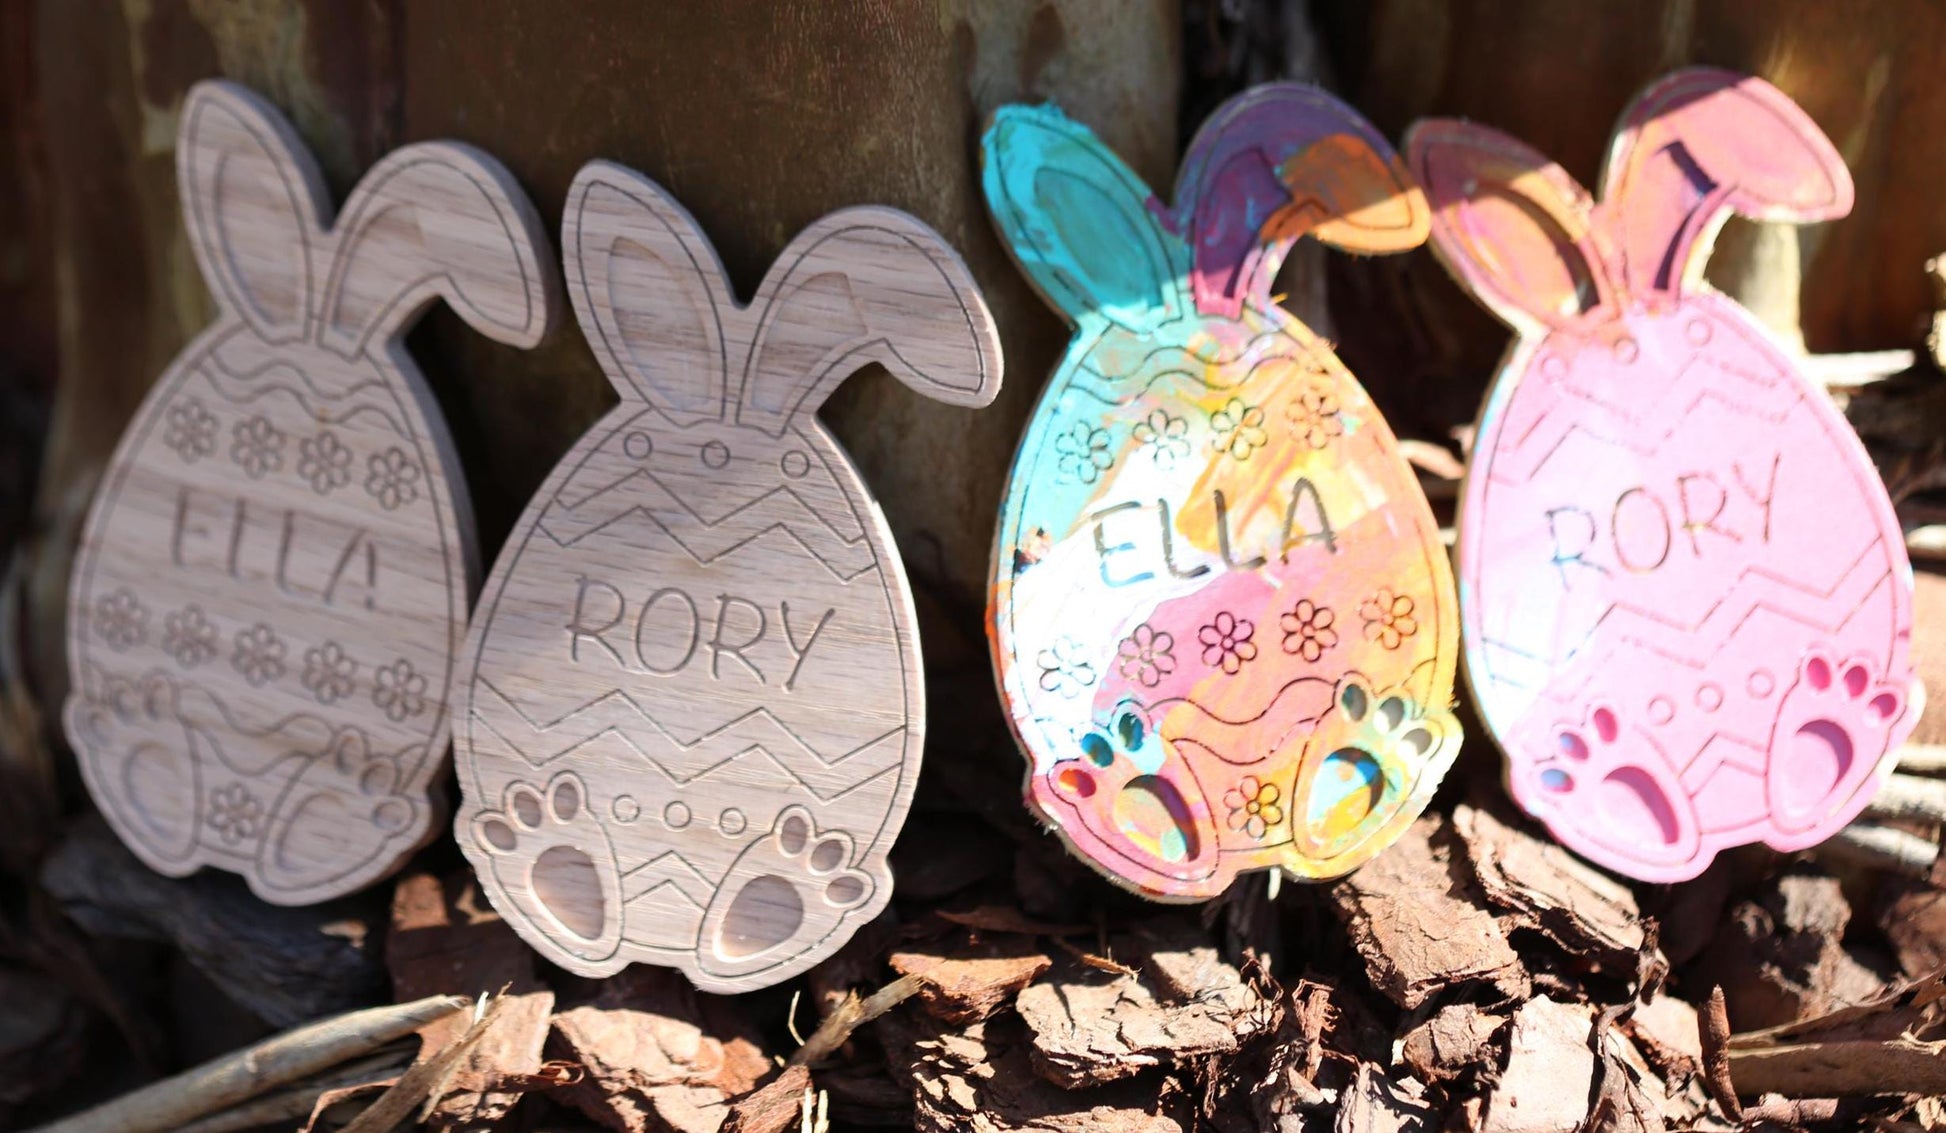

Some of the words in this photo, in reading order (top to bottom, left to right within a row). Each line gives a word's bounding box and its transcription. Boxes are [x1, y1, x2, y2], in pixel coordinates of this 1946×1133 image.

[169, 484, 378, 611] ELLA
[1089, 476, 1338, 588] ELLA
[1544, 451, 1781, 593] RORY
[564, 573, 836, 694] RORY
